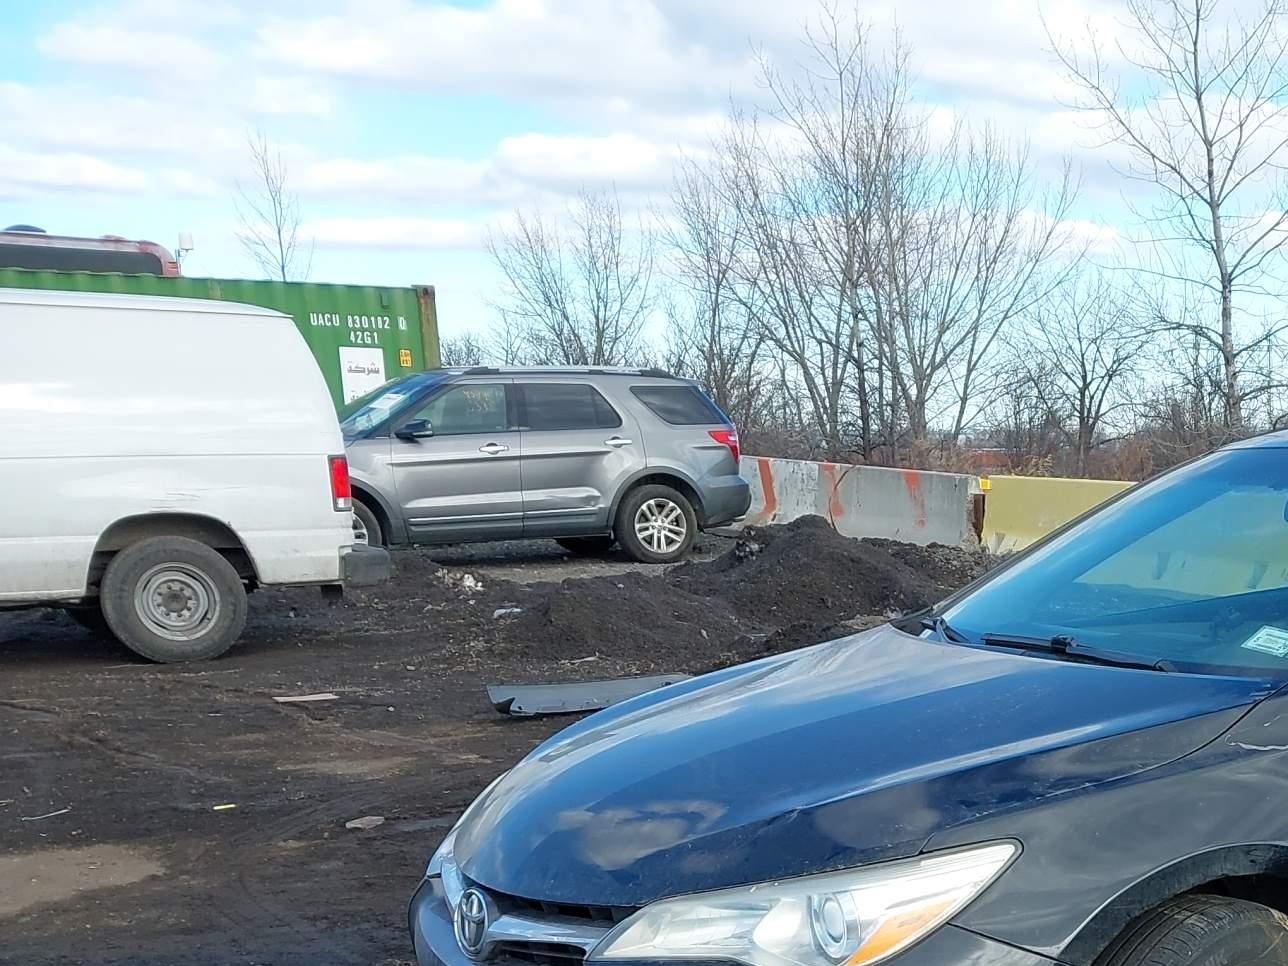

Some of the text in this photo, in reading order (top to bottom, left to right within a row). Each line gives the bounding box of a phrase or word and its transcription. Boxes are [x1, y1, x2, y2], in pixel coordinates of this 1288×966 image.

[310, 312, 340, 327] UACU
[347, 315, 391, 329] 830182
[349, 331, 379, 345] 42G1
